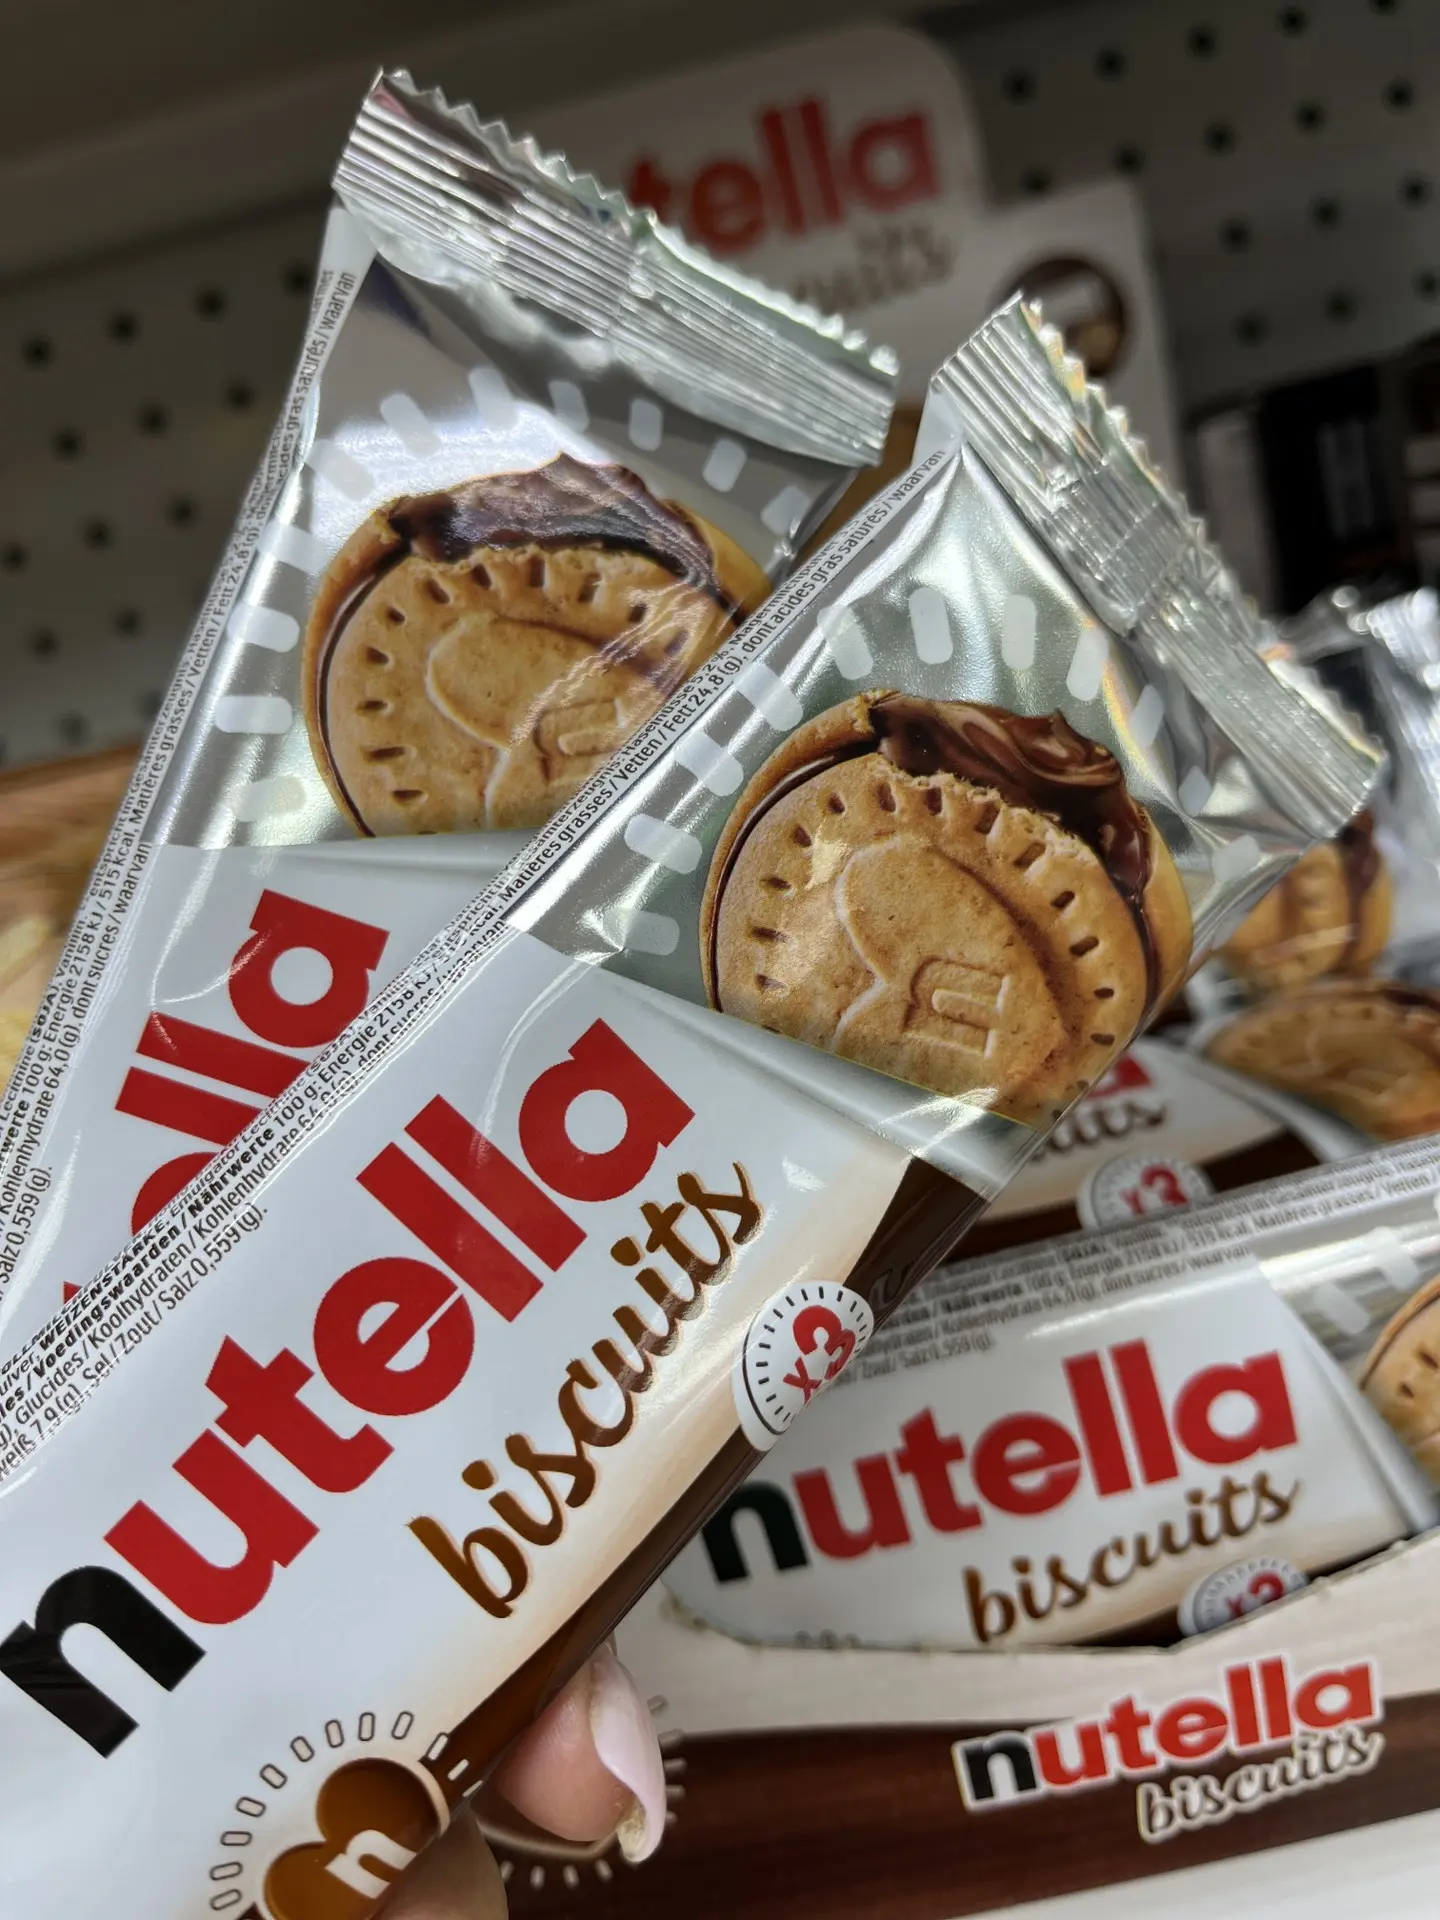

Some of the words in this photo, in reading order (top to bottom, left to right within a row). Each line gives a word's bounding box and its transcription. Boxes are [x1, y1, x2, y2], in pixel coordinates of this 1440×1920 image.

[21, 1061, 44, 1096] 100
[42, 977, 80, 1042] Energie
[68, 930, 96, 977] 2158
[86, 909, 104, 930] kJ
[98, 866, 121, 900] 515
[157, 686, 193, 753] grasses
[31, 1223, 182, 1379] Voedingswaarden
[185, 1125, 276, 1218] Nährwerte
[272, 1093, 306, 1129] 100
[316, 1022, 378, 1084] Energie
[372, 986, 415, 1028] 2158
[497, 838, 562, 904] Matières
[556, 785, 613, 845] grasses
[612, 734, 663, 785] Vetten
[661, 702, 696, 735] Fett
[687, 672, 725, 709] 24,8
[738, 618, 777, 656] dont
[769, 577, 816, 625] acides
[810, 549, 845, 587] gras
[837, 503, 888, 556] saturés
[43, 1047, 72, 1091] 64,0
[4, 1190, 41, 1246] 0,559
[10, 1349, 86, 1427] Glucides
[84, 1240, 193, 1350] Koolhydraten
[190, 1125, 305, 1240] Kohlenhydrate
[0, 1433, 37, 1482] eiß
[79, 1351, 115, 1389] Sel
[113, 1308, 159, 1356] Zout
[155, 1266, 199, 1312] Salz
[187, 1222, 244, 1280] 0,559
[231, 1195, 269, 1235] (g).
[0, 1348, 42, 1396] ulver,
[0, 1017, 696, 1759] nutella
[405, 1161, 764, 1619] biscuits
[784, 1304, 856, 1402] x3
[702, 1337, 1299, 1585] nutella
[962, 1470, 1300, 1644] biscuits
[962, 1655, 1378, 1803] nutella
[1140, 1727, 1382, 1839] biscuits
